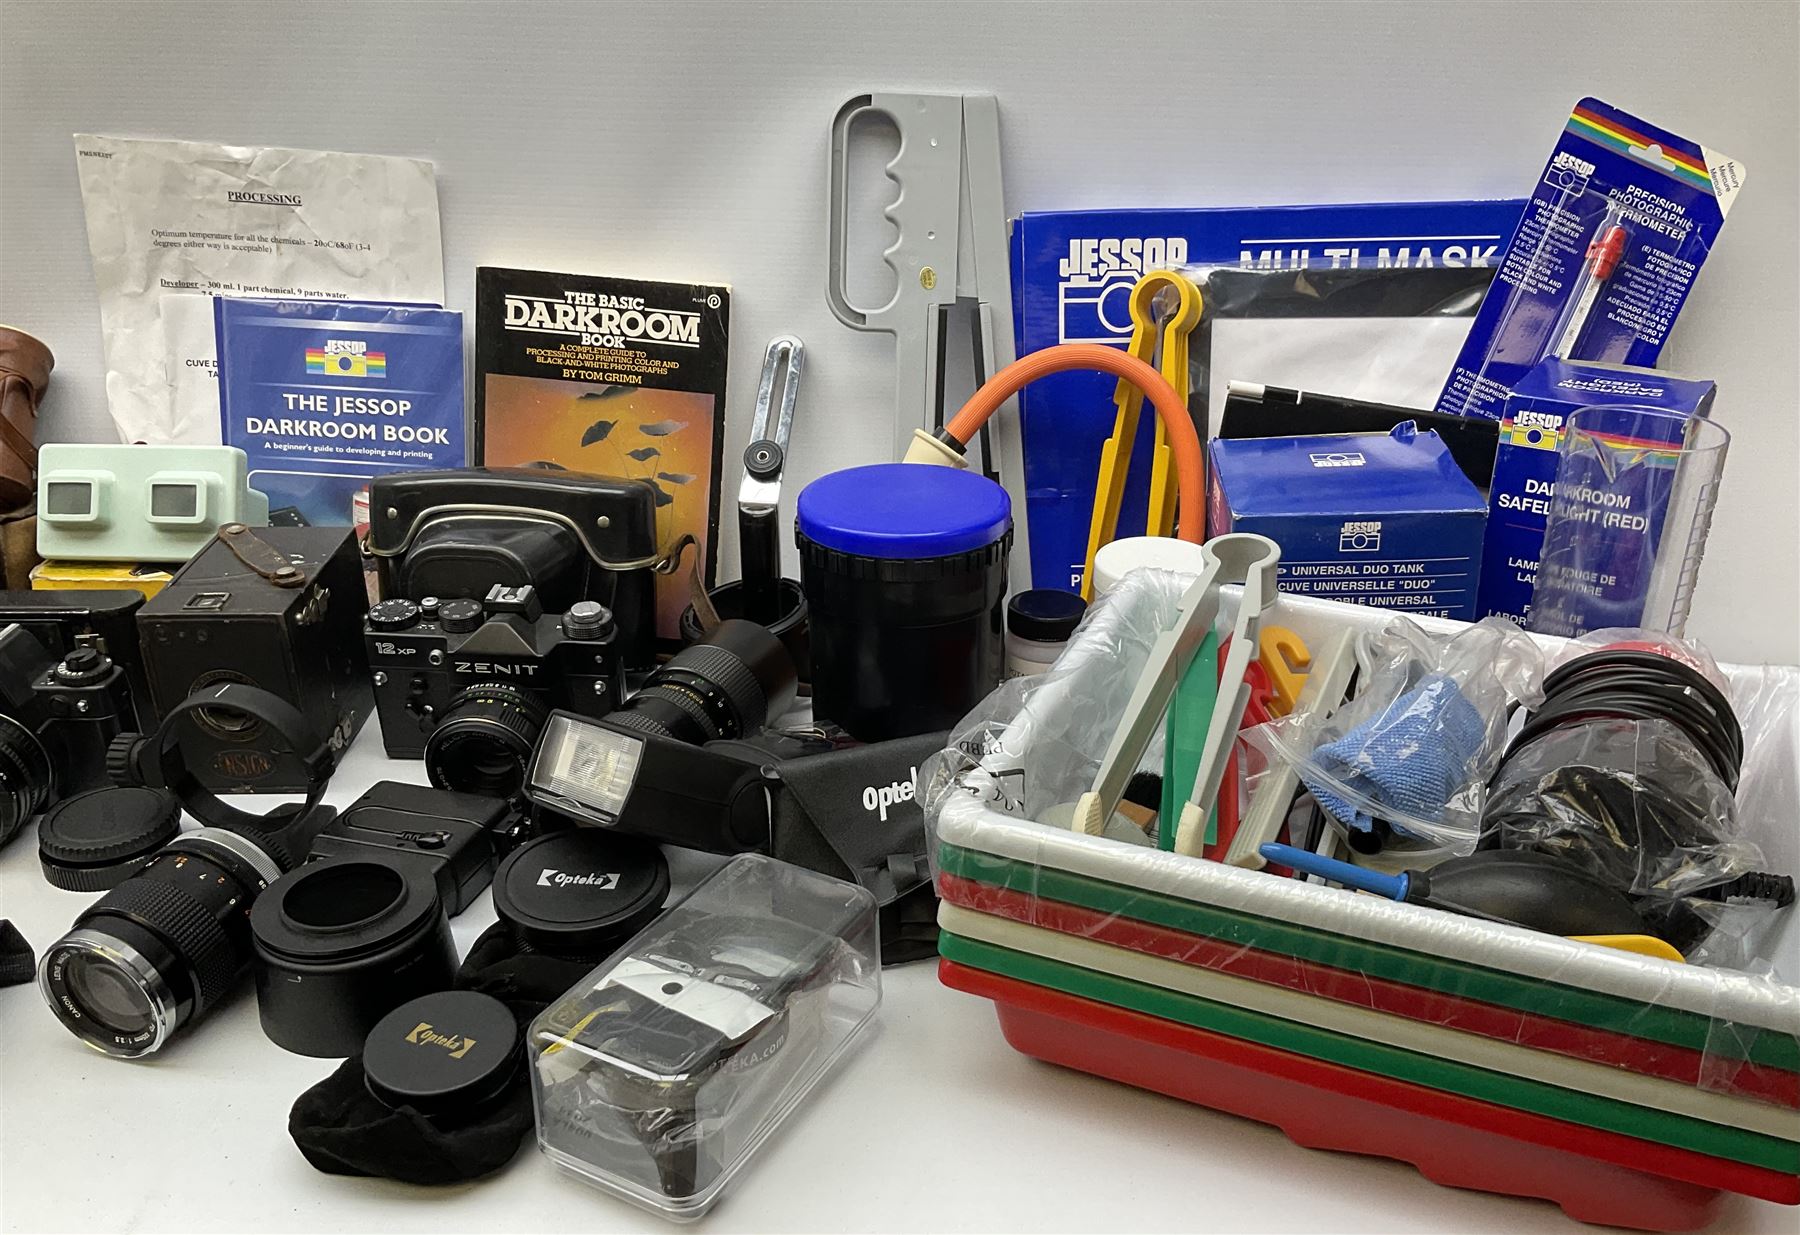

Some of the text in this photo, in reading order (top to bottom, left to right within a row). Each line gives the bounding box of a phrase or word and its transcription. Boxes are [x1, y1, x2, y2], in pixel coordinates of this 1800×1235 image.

[1554, 151, 1596, 177] JESSOP
[1718, 164, 1731, 192] Mercure
[1727, 161, 1739, 188] Mercury
[227, 190, 303, 205] PROCESSING
[1626, 185, 1685, 216] PRECISION
[1609, 188, 1694, 230] PHOTOGRAPHIC
[151, 228, 187, 238] Optimum
[188, 231, 232, 241] temperature
[246, 234, 257, 242] all
[258, 234, 270, 243] the
[270, 236, 307, 246] chemicals
[153, 240, 182, 250] degrees
[206, 243, 222, 252] way
[231, 244, 272, 254] acceptable)
[1060, 238, 1187, 276] JESSOP
[1505, 260, 1523, 271] BOTH
[1548, 279, 1562, 288] AND
[1538, 266, 1551, 275] FOR
[160, 278, 200, 290] Developer
[244, 285, 260, 293] part
[260, 286, 297, 296] chemical,
[304, 290, 324, 298] parts
[326, 292, 350, 300] water.
[1502, 267, 1523, 279] BLACK
[1536, 282, 1556, 294] WHITE
[564, 291, 645, 310] THE BASIC
[1607, 296, 1642, 313] ADECUADO
[504, 300, 700, 342] DARKROOM
[1656, 324, 1667, 332] EN
[324, 340, 366, 354] JESSOP
[581, 332, 626, 348] BOOK
[1636, 332, 1659, 345] COLOR
[526, 348, 680, 368] PROCESSING AND PRINTING COLOR AND
[566, 344, 610, 355] COMPLETE
[610, 348, 634, 357] GUIDE
[636, 350, 647, 358] TO
[186, 360, 210, 368] CUVE
[536, 356, 668, 375] BLACK-AND-WHITE PHOTOGRAPHS
[562, 368, 642, 384] BY TOM GRIMM
[283, 394, 412, 416] THE JESSOP
[1514, 410, 1563, 430] JESSOP
[246, 418, 450, 444] DARKROOM BOOK
[273, 442, 312, 454] beginner's
[314, 444, 334, 454] guide
[346, 447, 386, 458] developing
[402, 450, 434, 460] printing
[1340, 522, 1382, 534] JESSOP
[1603, 512, 1650, 534] (RED)
[1292, 566, 1360, 576] UNIVERSAL
[1362, 564, 1389, 574] DUO
[1392, 564, 1425, 573] TANK
[1278, 580, 1436, 592] CUVE UNIVERSELLE "DUO"
[1600, 574, 1616, 586] DE
[1369, 596, 1436, 606] UNIVERSAL
[376, 642, 396, 654] 12
[455, 662, 538, 676] ZENIT
[554, 871, 603, 887] Opteka
[62, 995, 81, 1018] CANON
[420, 1028, 462, 1052] Opteka
